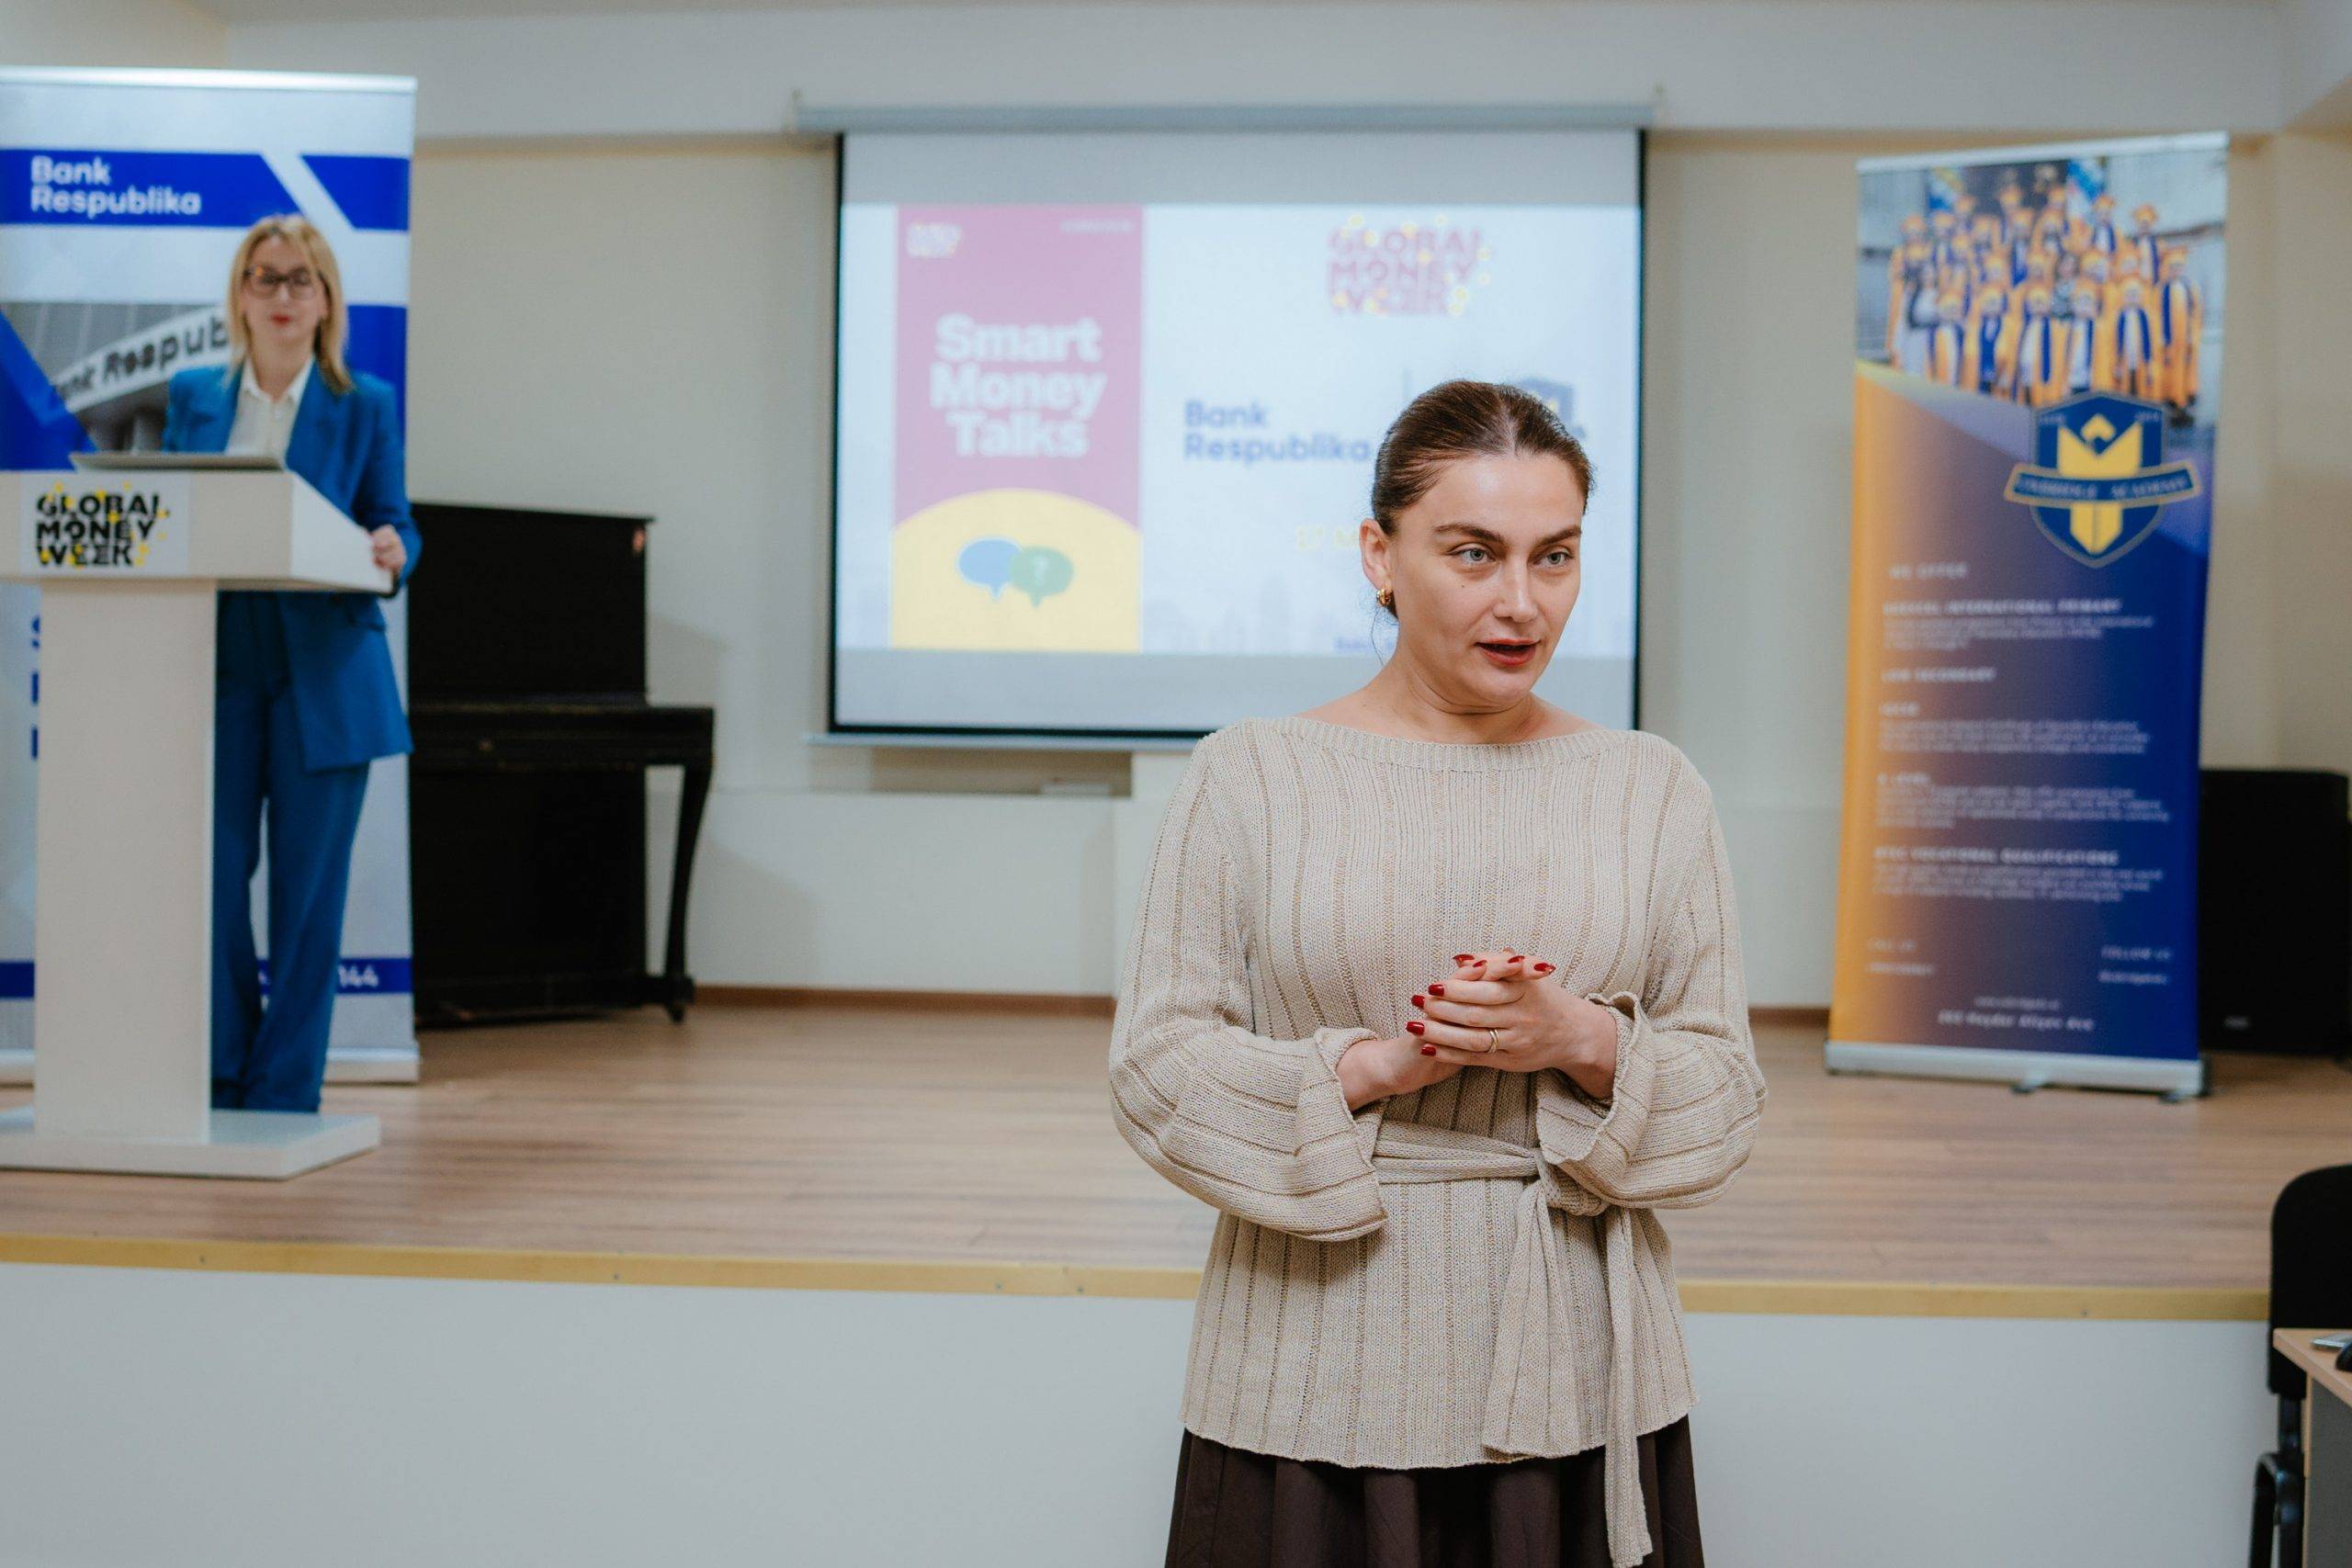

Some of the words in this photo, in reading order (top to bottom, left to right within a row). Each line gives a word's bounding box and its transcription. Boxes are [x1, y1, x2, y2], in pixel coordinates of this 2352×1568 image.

[30, 155, 111, 186] Bank
[30, 185, 201, 219] Respublika
[103, 315, 229, 383] Respub
[935, 312, 1102, 362] Smart
[930, 361, 1107, 421] Money
[1184, 400, 1267, 428] Bank
[945, 410, 1089, 458] Talks
[1184, 433, 1374, 465] Respublika
[37, 493, 165, 517] GLOBAL
[37, 519, 157, 542] MONEY
[37, 544, 135, 567] WEEK
